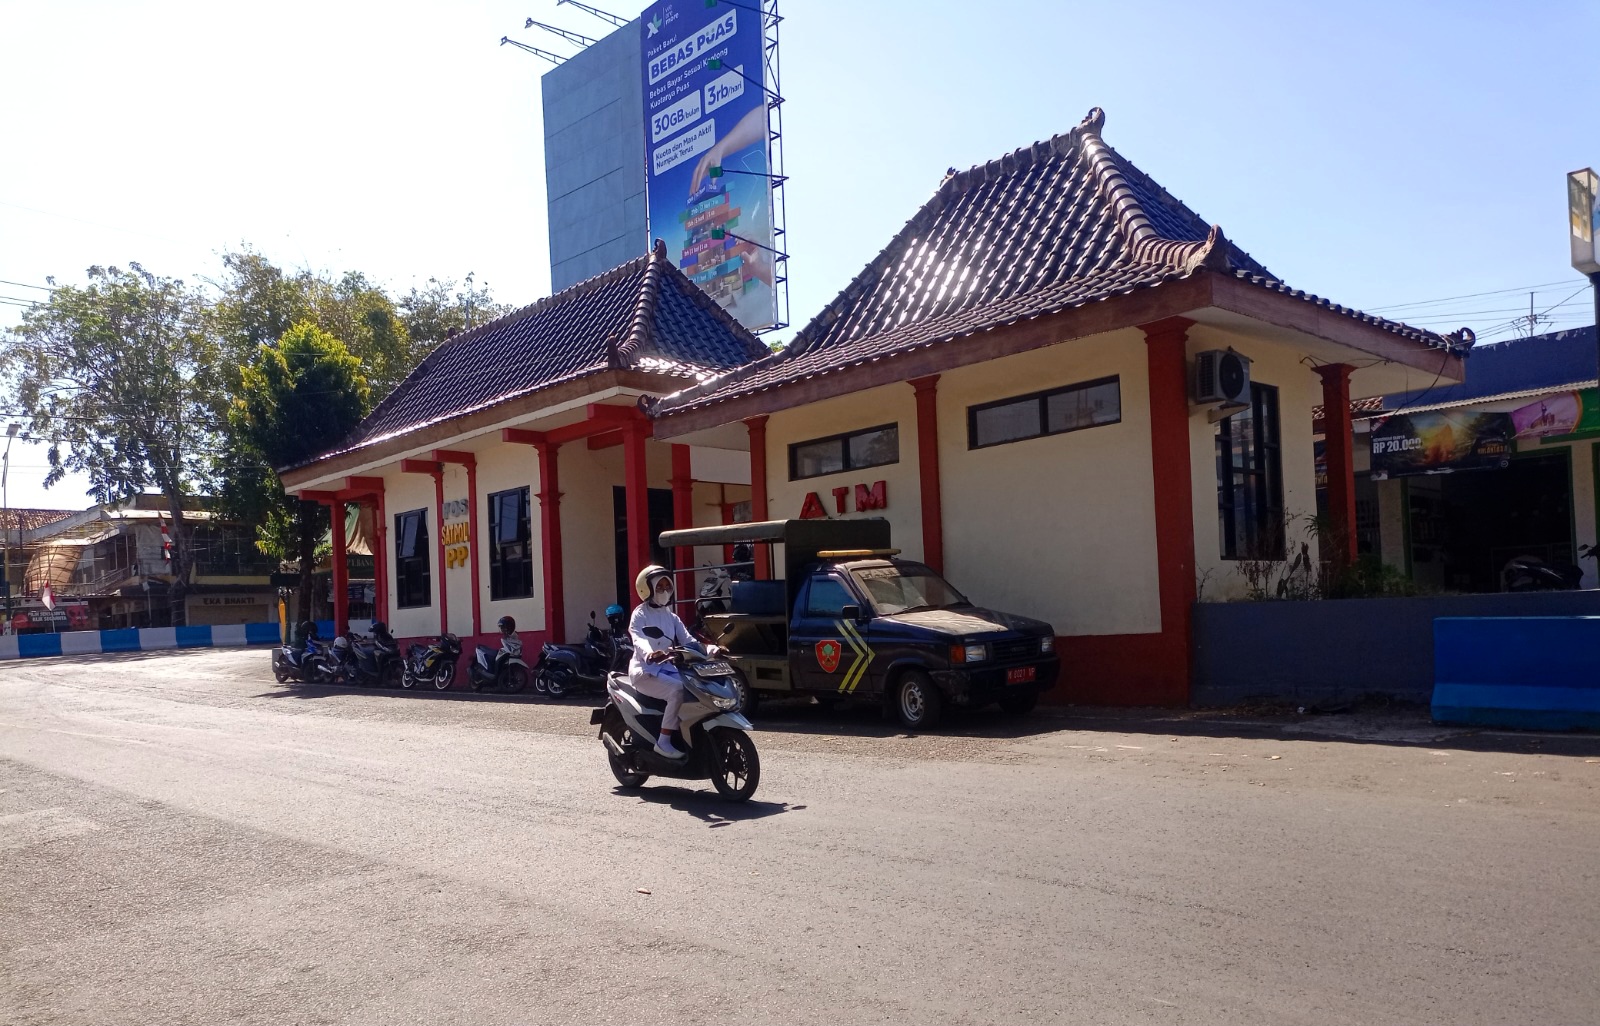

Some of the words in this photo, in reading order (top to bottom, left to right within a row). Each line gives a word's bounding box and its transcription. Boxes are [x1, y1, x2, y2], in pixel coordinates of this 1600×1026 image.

[665, 12, 679, 25] more
[647, 43, 663, 58] Paket
[651, 42, 694, 80] BEBAS
[650, 84, 667, 99] Bebas
[667, 73, 683, 90] Bayar
[684, 63, 703, 79] Sesuai
[676, 82, 690, 95] Puas
[655, 148, 672, 161] Kuota
[672, 142, 683, 153] dan
[683, 134, 697, 146] Masa
[698, 124, 712, 139] Aktif
[656, 154, 679, 169] Numpuk
[679, 145, 694, 157] Terus
[1373, 442, 1386, 454] RP
[442, 499, 468, 519] POS
[799, 481, 888, 519] ATM
[441, 522, 470, 546] SATPOL
[446, 546, 468, 569] PP
[224, 597, 255, 605] BHAKTI
